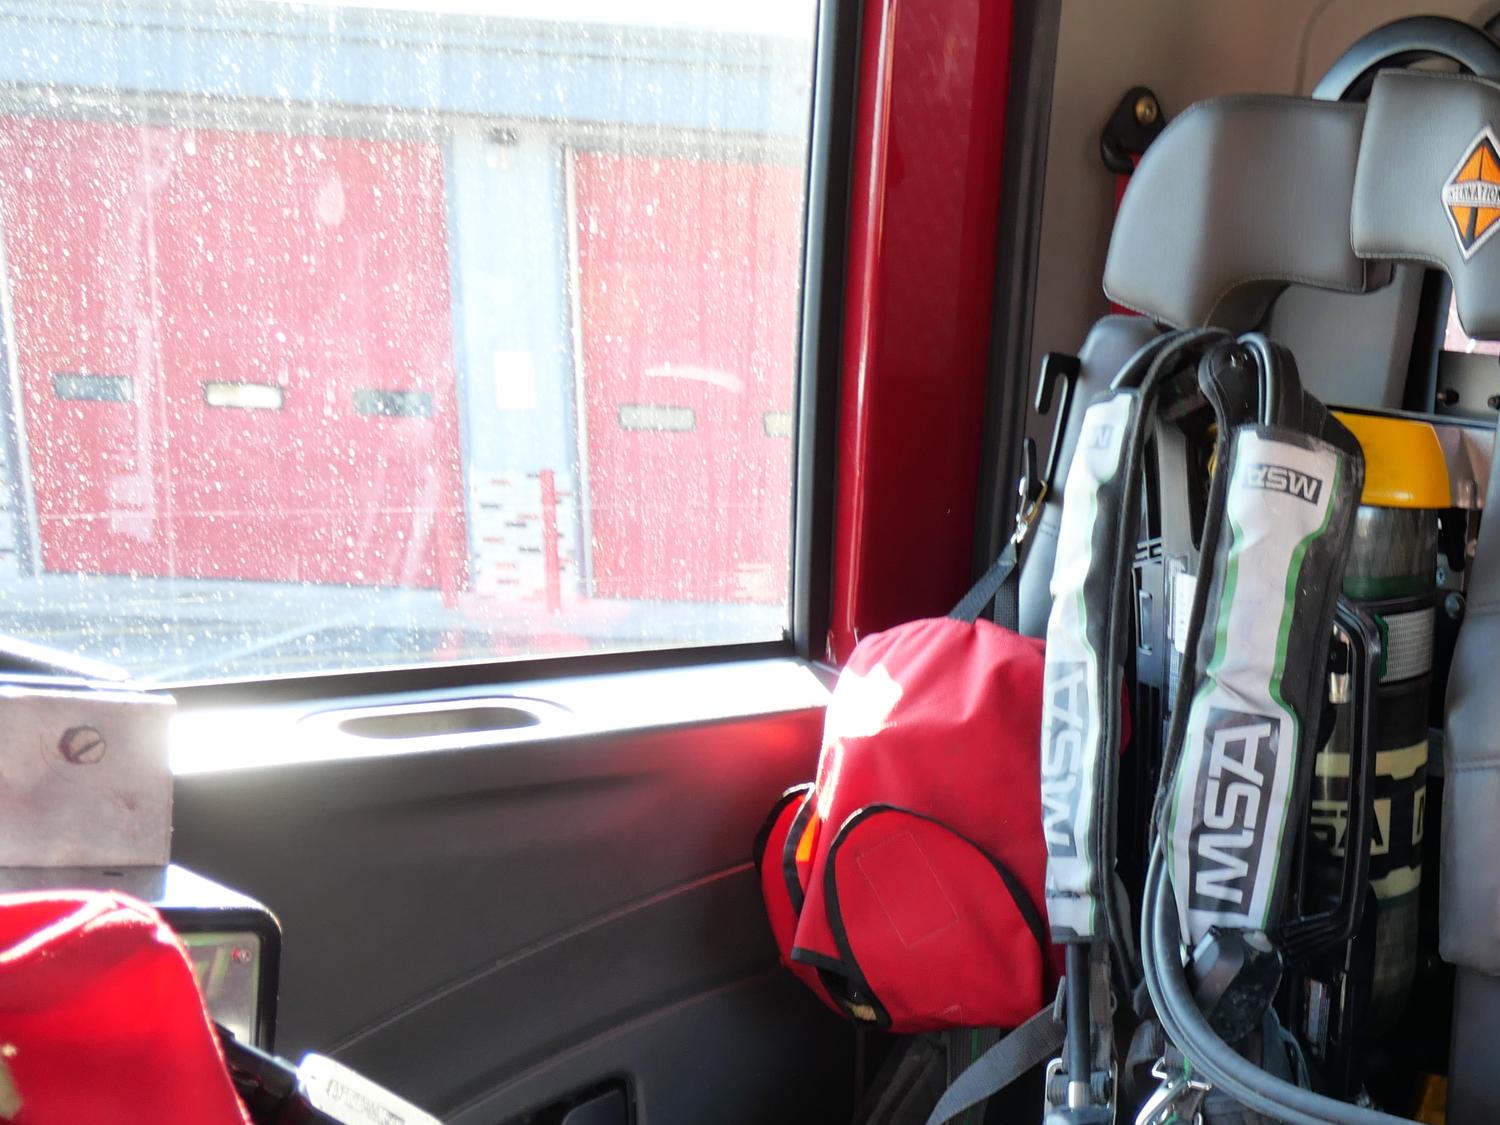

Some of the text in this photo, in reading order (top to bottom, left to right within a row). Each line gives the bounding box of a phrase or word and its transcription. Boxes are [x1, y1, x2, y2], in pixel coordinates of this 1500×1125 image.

[1249, 464, 1319, 501] MSA
[1043, 667, 1084, 847] MSA
[1195, 722, 1272, 905] MSA
